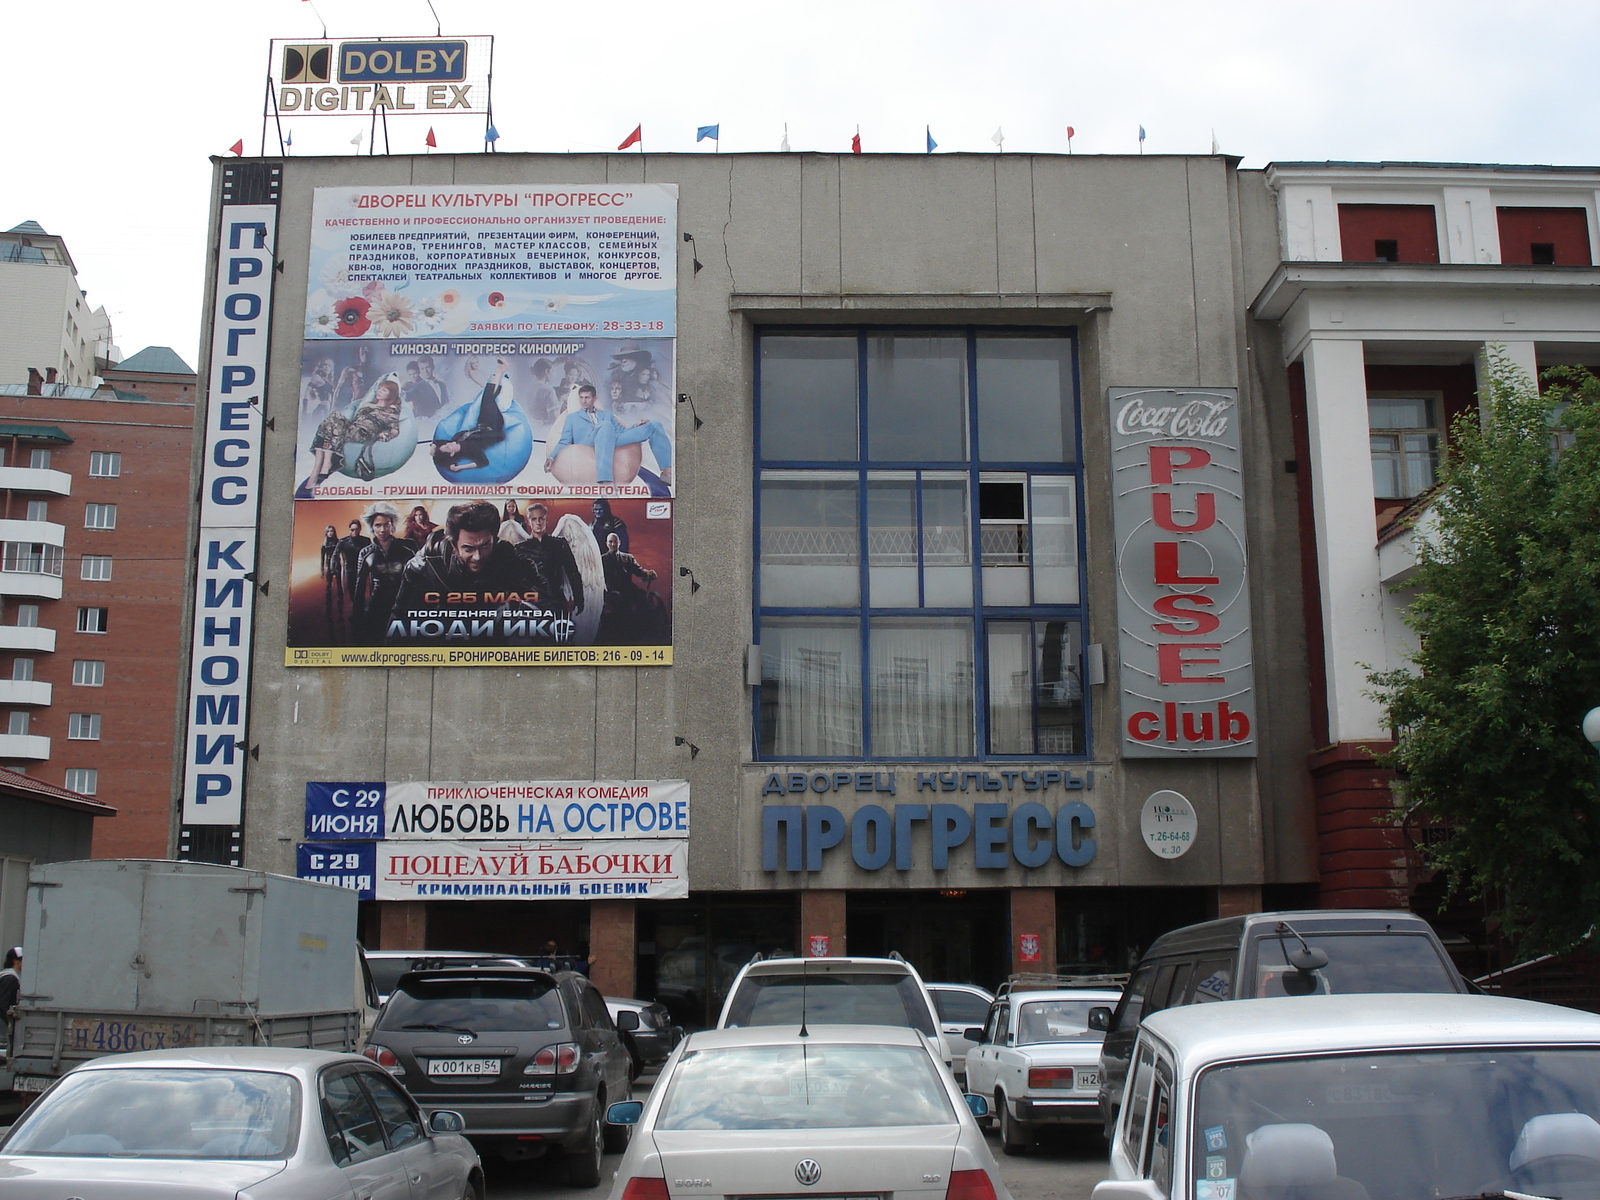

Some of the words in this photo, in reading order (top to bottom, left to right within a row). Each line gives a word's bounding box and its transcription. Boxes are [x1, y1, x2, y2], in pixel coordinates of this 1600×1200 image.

[345, 49, 461, 75] DOLBY
[279, 86, 416, 111] DIGITAL
[426, 85, 472, 110] EX
[357, 194, 426, 208] ДВОРЕЦ
[432, 193, 518, 208] КУЛЬТУРЫ
[524, 192, 633, 207] “ПРОГРЕСС”
[325, 218, 400, 227] КАЧЕСТВЕННО
[403, 217, 410, 226] И
[413, 216, 521, 226] ПРОФЕССИОНАЛЬНО
[524, 216, 590, 225] ОРГАНИЗУЕТ
[594, 216, 667, 225] ПРОВЕДЕНИЕ:
[350, 232, 396, 241] ЮБИЛЕЕВ
[399, 231, 470, 241] ПРЕДПРИЯТИЙ,
[477, 232, 546, 241] ПРЕЗЕНТАЦИИ
[548, 231, 579, 241] ФИРМ,
[586, 230, 660, 240] КОНФЕРЕНЦИЙ,
[349, 243, 416, 252] СЕМИНАРОВ,
[421, 242, 486, 251] ТРЕНИНГОВ,
[494, 242, 536, 250] МАСТЕР
[538, 241, 590, 251] КЛАССОВ,
[598, 240, 658, 249] СЕМЕЙНЫХ
[349, 253, 419, 262] ПРАЗДНИКОВ,
[426, 252, 516, 261] КОРПОРАТИВНЫХ
[526, 252, 590, 260] ВЕЧЕРИНОК,
[597, 251, 660, 260] КОНКУРСОВ,
[392, 262, 457, 271] НОВОГОДНИХ
[465, 262, 531, 271] ПРАЗДНИКОВ,
[539, 262, 595, 271] ВЫСТАВОК,
[599, 261, 660, 271] КОНЦЕРТОВ,
[347, 272, 407, 282] СПЕКТАКЛЕЙ
[415, 272, 482, 281] ТЕАТРАЛЬНЫХ
[490, 272, 557, 280] КОЛЛЕКТИВОВ
[564, 272, 571, 280] И
[579, 272, 617, 280] МНОГОЕ
[624, 272, 662, 281] ДРУГОЕ.
[470, 322, 514, 331] ЗАЯВКИ
[517, 322, 533, 331] ПО
[542, 322, 599, 331] ТЕЛЕФОНУ:
[602, 321, 664, 331] 28-33-18
[391, 343, 448, 355] КИНОЗАЛ
[451, 342, 516, 355] “ПРОГРЕСС
[519, 342, 585, 355] КИНОМИР”
[211, 222, 266, 506] ПРОГРЕСС
[1116, 398, 1234, 437] Coca-Cola
[313, 486, 373, 496] БАОБАБЫ
[431, 485, 513, 495] ПРИНИМАЮТ
[517, 485, 564, 495] ФОРМУ
[568, 485, 614, 495] ТВОЕГО
[617, 485, 649, 495] ТЕЛА
[1149, 445, 1226, 686] PULSE
[424, 592, 440, 604] С
[447, 592, 477, 604] 25
[484, 592, 539, 604] МАЯ
[407, 610, 498, 618] ПОСЛЕДНЯЯ
[502, 610, 553, 618] БИТВА
[386, 619, 495, 638] ЛЮДИ
[341, 651, 446, 666] www.dkprogress.ru,
[449, 650, 541, 662] БРОНИРОВАНИЕ
[543, 650, 600, 662] БИЛЕТОВ:
[195, 540, 247, 805] КИНОМИР
[1127, 702, 1251, 742] club
[762, 772, 896, 796] ДВОРЕЦ
[917, 770, 1095, 793] КУЛЬТУРЫ
[332, 789, 350, 808] С
[355, 789, 381, 808] 29
[427, 787, 573, 800] ПРИКЛЮЧЕНЧЕСКАЯ
[578, 786, 649, 801] КОМЕДИЯ
[311, 814, 379, 834] ИЮНЯ
[391, 803, 510, 833] ЛЮБОВЬ
[518, 803, 555, 833] НА
[563, 801, 687, 833] ОСТРОВЕ
[762, 801, 1097, 873] ПРОГРЕСС
[310, 854, 324, 870] С
[329, 853, 359, 870] 29
[388, 852, 530, 877] ПОЦЕЛУЙ
[538, 854, 673, 875] БАБОЧКИ
[417, 882, 571, 896] КРИМИНАЛЬНЫЙ
[579, 882, 649, 895] БОЕВИК
[484, 1060, 496, 1070] 54
[675, 1179, 713, 1188] BORA
